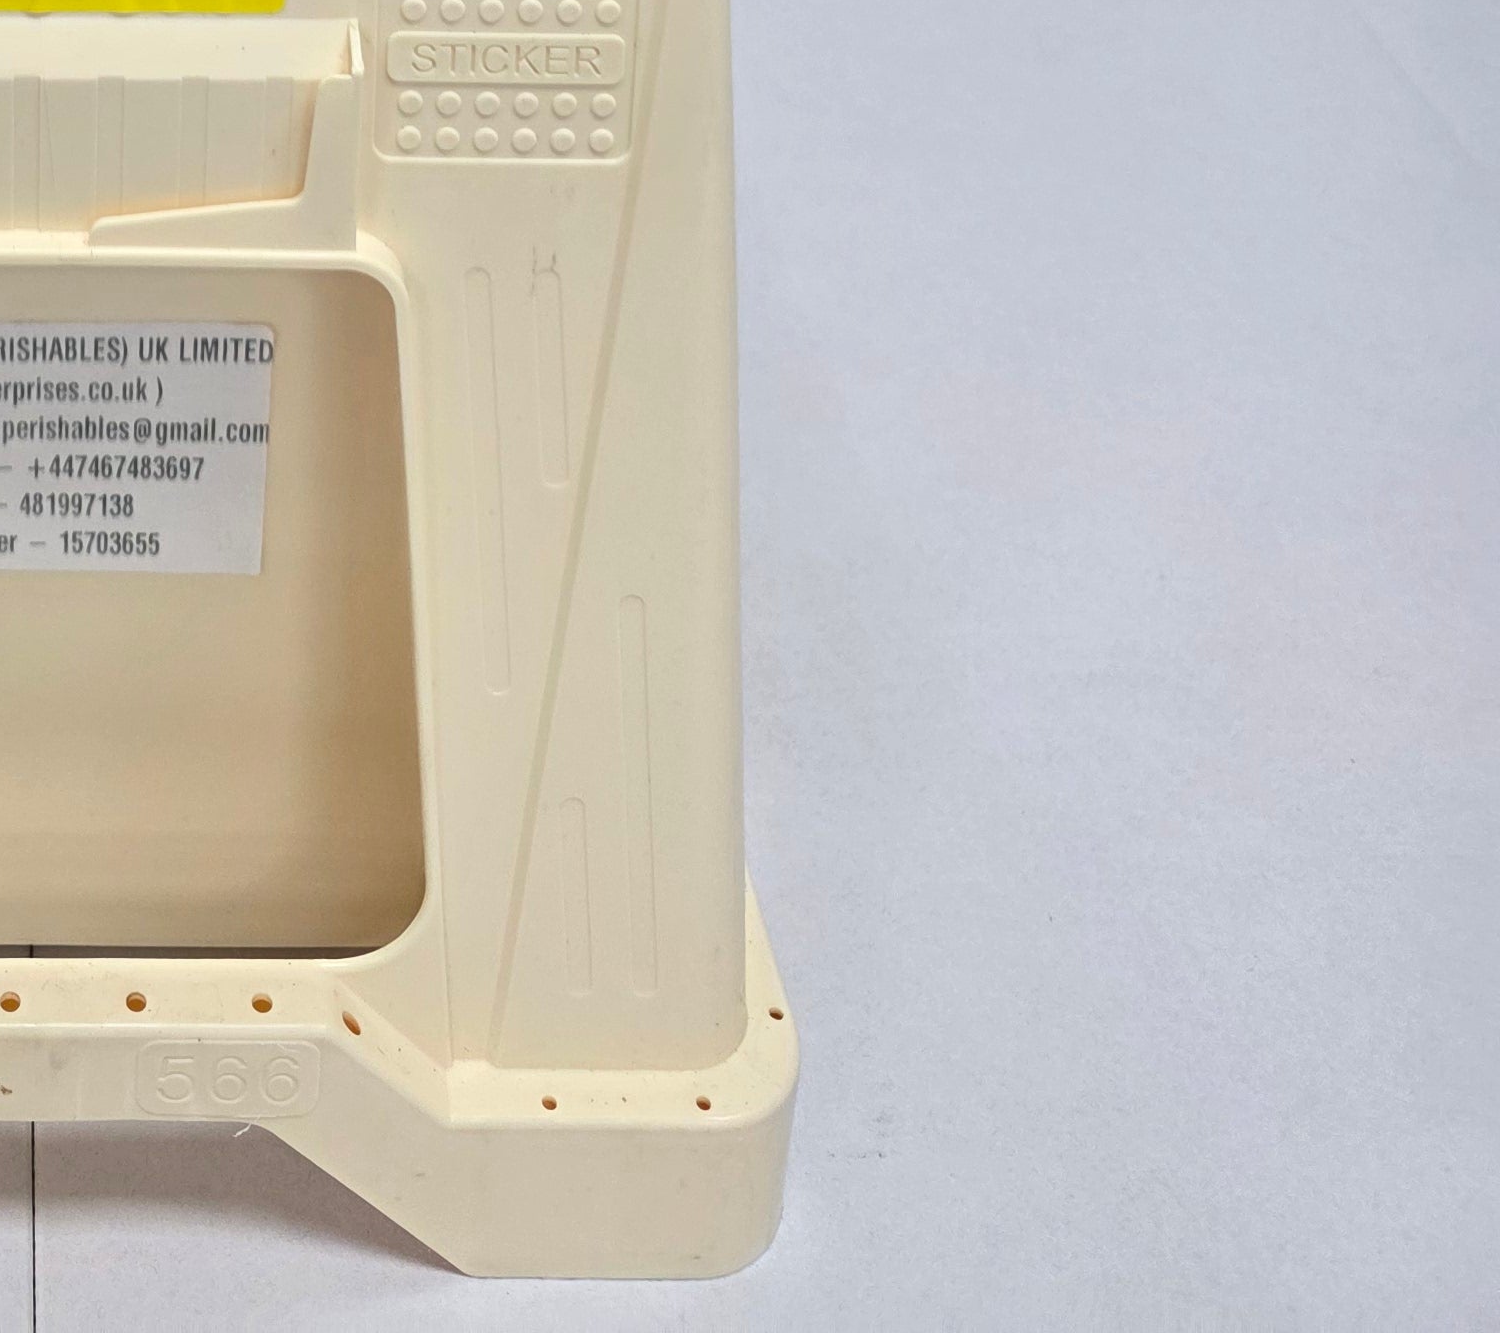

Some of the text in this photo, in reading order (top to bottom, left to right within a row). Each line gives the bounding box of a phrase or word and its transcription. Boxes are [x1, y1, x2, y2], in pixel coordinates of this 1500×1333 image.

[411, 44, 602, 75] STICKER
[139, 337, 169, 362] UK
[179, 337, 273, 363] LIMITED
[28, 455, 205, 480] +447467483697
[19, 492, 134, 517] 481997138
[60, 531, 160, 556] 15703655
[155, 1055, 301, 1107] 566
